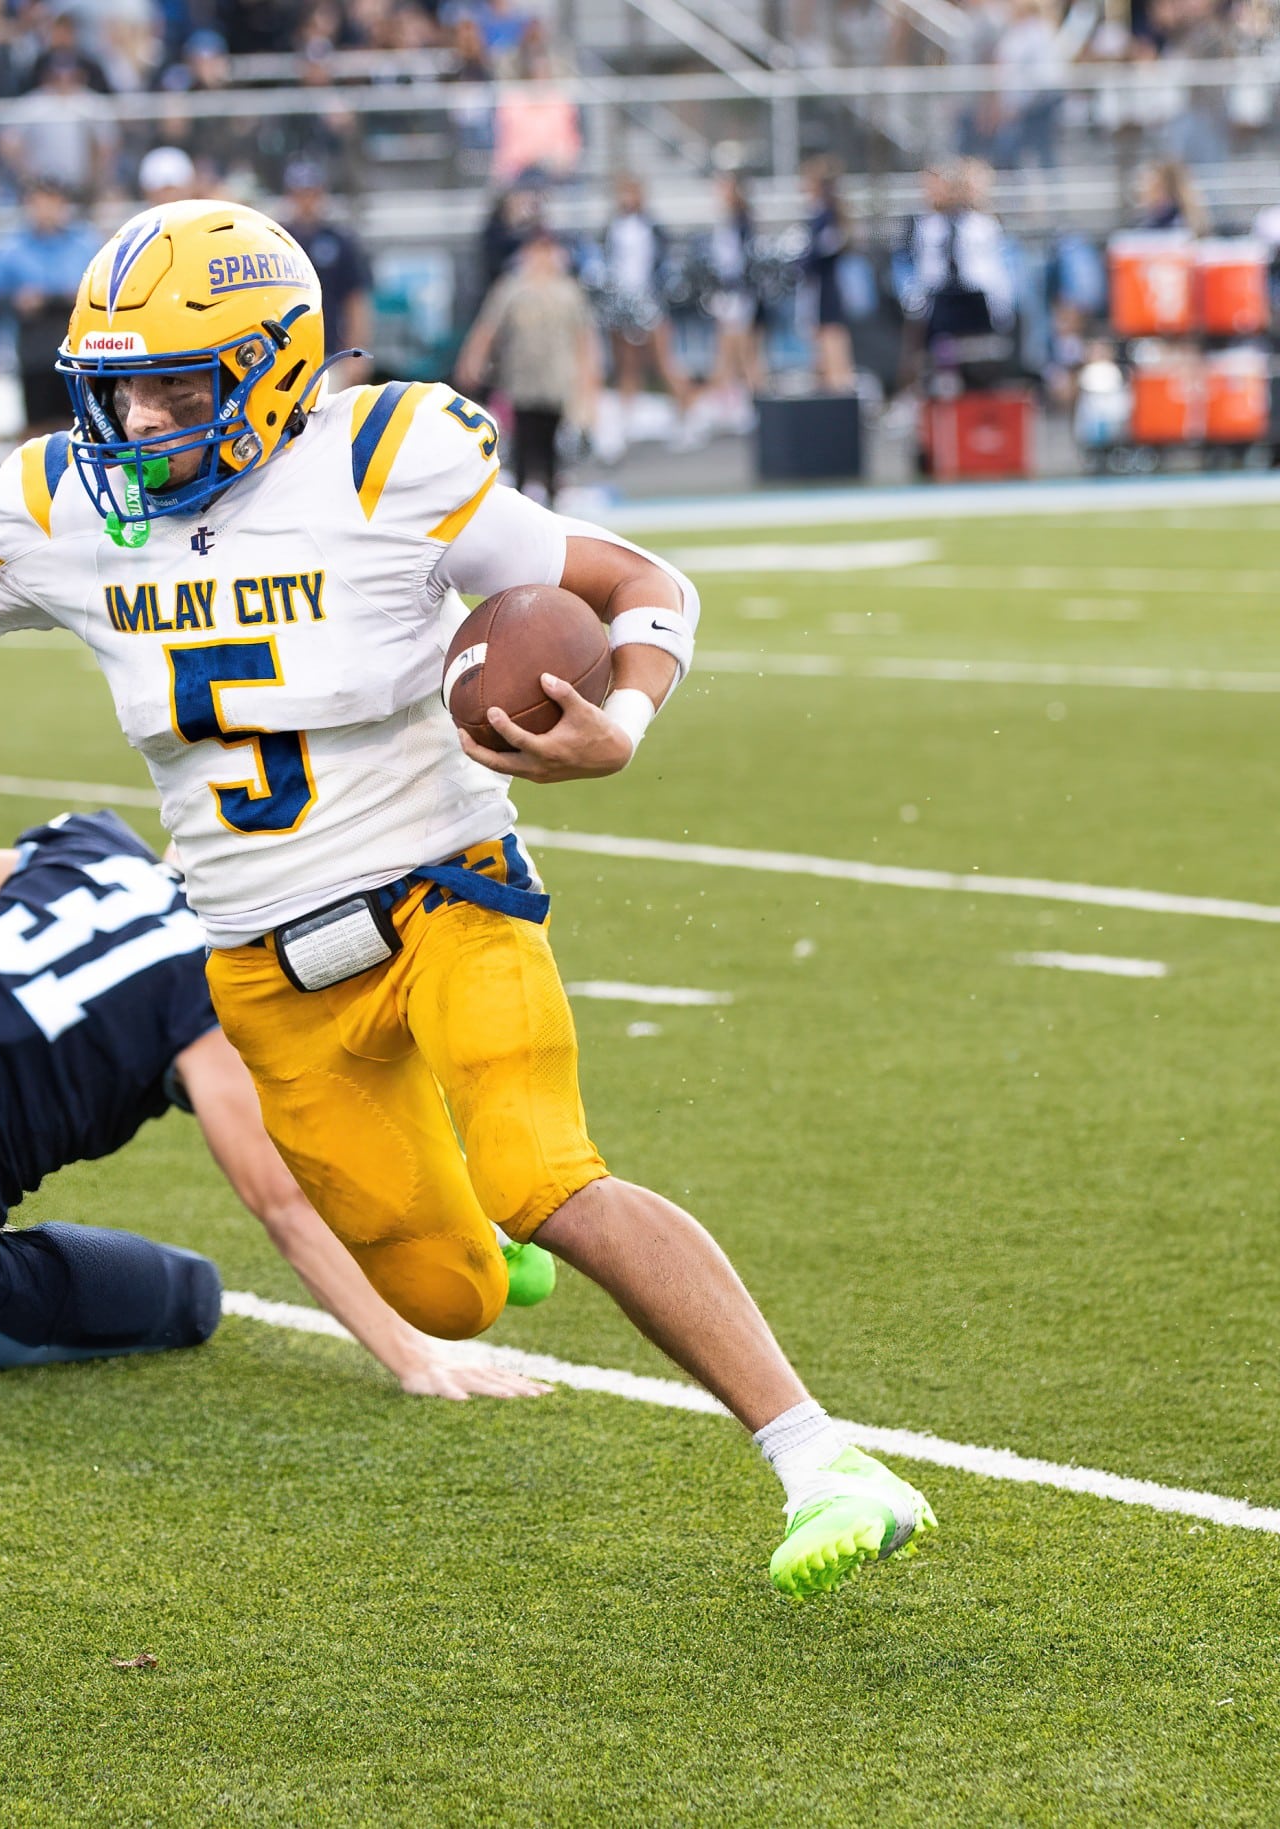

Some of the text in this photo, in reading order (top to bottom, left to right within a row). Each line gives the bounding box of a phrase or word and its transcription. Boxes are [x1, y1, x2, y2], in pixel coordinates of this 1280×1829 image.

[85, 337, 133, 350] Riddell
[441, 394, 498, 461] 5
[127, 484, 147, 532] NXTRD
[103, 569, 326, 634] IMLAY CITY
[162, 635, 318, 836] 5
